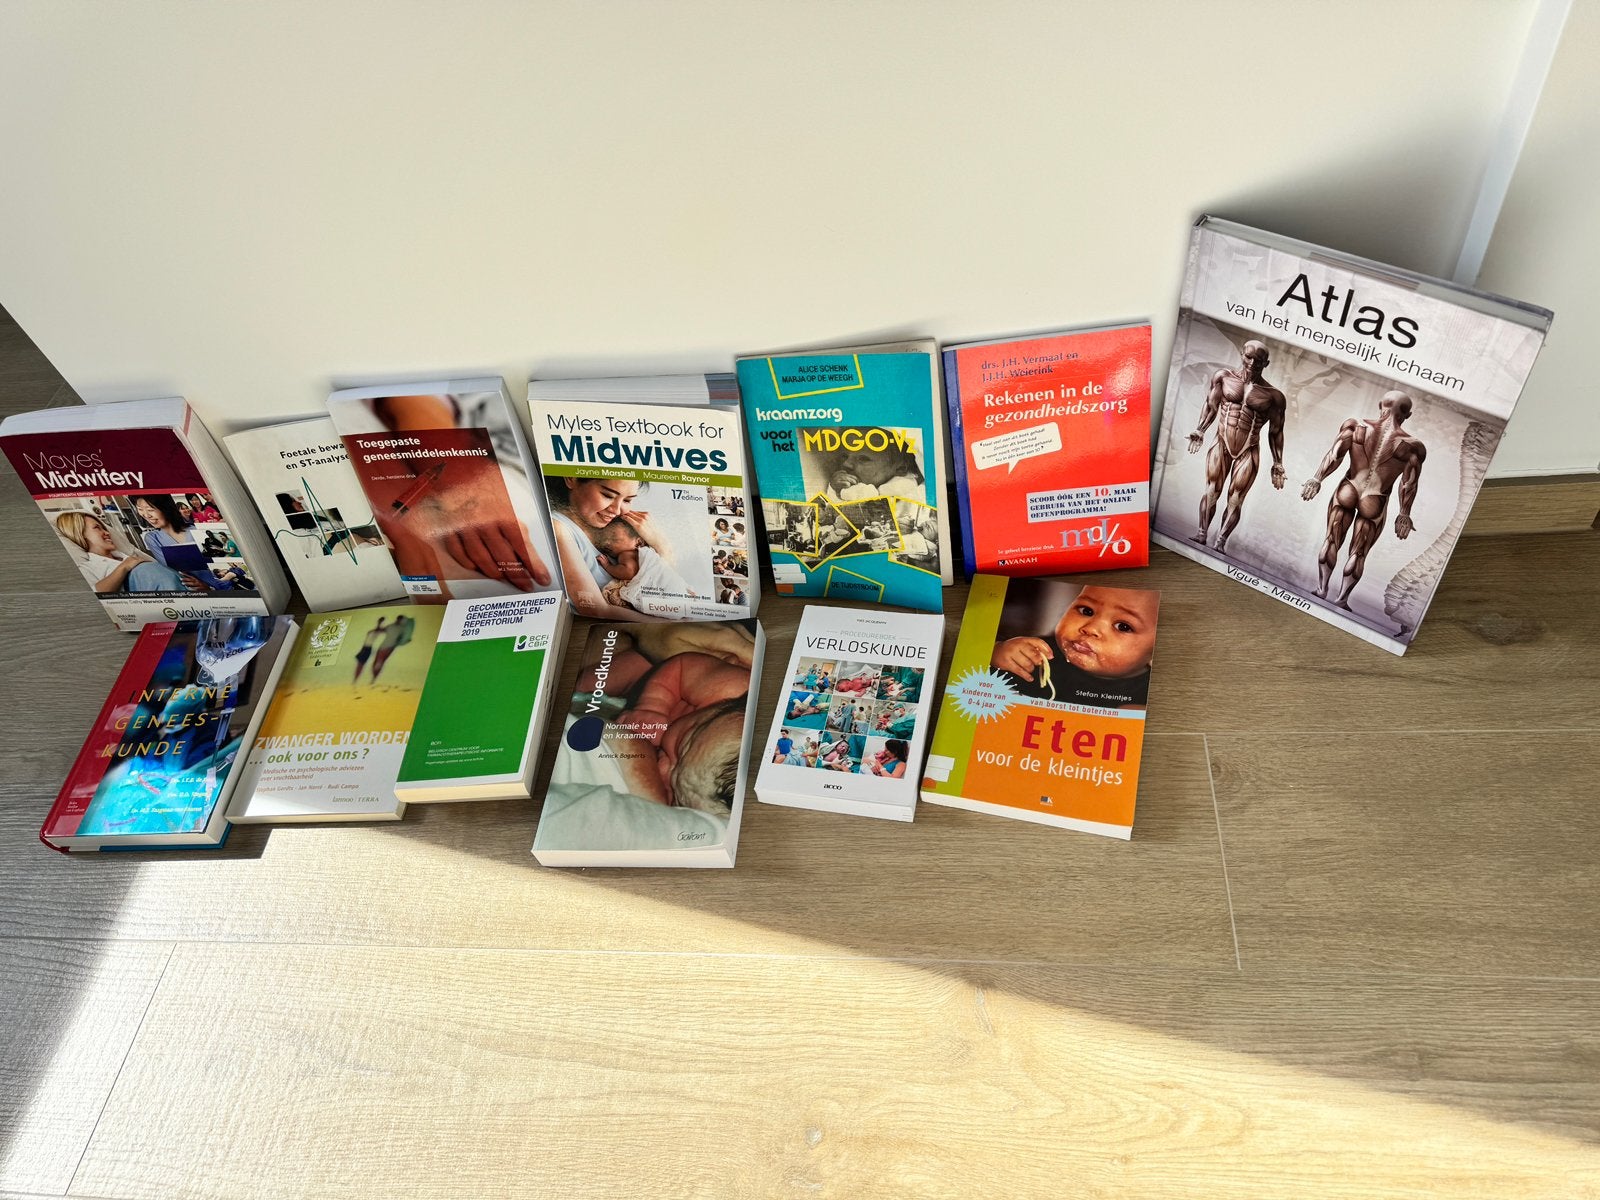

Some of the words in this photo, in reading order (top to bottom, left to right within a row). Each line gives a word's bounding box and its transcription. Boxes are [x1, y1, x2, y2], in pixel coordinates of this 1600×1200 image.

[1276, 273, 1420, 349] Atlas
[1225, 300, 1257, 321] van
[1261, 309, 1291, 332] het
[1294, 322, 1382, 364] menselijk
[1387, 352, 1466, 392] lichaam
[798, 365, 818, 373] ALICE
[819, 364, 849, 373] SCHENK
[981, 360, 1000, 370] drs.
[1002, 357, 1021, 369] J.H.
[1066, 352, 1079, 360] en
[781, 374, 807, 383] MARJA
[807, 374, 817, 383] OP
[817, 374, 827, 382] DE
[828, 373, 854, 382] WEEGH
[983, 388, 1055, 408] Rekenen
[1060, 384, 1077, 398] in
[1081, 381, 1103, 396] de
[755, 407, 843, 423] kraamzorg
[983, 398, 1128, 429] gezondheidszorg
[547, 413, 602, 434] Myles
[605, 416, 694, 438] Textbook
[698, 422, 724, 439] for
[759, 430, 793, 440] voor
[356, 436, 421, 450] Toegepaste
[771, 440, 795, 453] het
[280, 446, 317, 460] Foetale
[363, 447, 489, 464] geneesmiddelenkennis
[550, 434, 728, 472] Midwives
[285, 462, 298, 471] en
[34, 468, 144, 490] Midwifery
[574, 468, 600, 478] Jayne
[601, 468, 636, 478] Marshall
[643, 471, 680, 482] Maureen
[681, 474, 711, 483] Raynor
[681, 494, 704, 502] edition
[1029, 495, 1055, 503] SCOOR
[1057, 492, 1074, 501] ÓÓK
[1076, 491, 1091, 499] EEN
[1094, 487, 1112, 497] 10.
[1113, 487, 1137, 495] MAAK
[1029, 502, 1066, 511] GEBRUIK
[1068, 500, 1083, 508] VAN
[1084, 498, 1102, 506] HET
[1102, 495, 1133, 504] ONLINE
[1030, 506, 1107, 519] OEFENPROGRAMMA!
[998, 556, 1038, 566] KAVANAH
[1225, 564, 1261, 588] Vigué
[831, 580, 840, 589] DE
[840, 581, 881, 592] TIJDSTROOM
[162, 605, 212, 620] evolve
[468, 597, 557, 613] GECOMMENTARIEERD
[648, 603, 680, 613] Evolve
[465, 606, 543, 621] GENEESMIDDELEN-
[463, 616, 524, 628] REPERTORIUM
[322, 625, 339, 636] 20
[461, 628, 480, 637] 2019
[839, 629, 897, 641] PROCEDUREBOEK
[806, 636, 928, 660] VERLOSKUNDE
[585, 630, 618, 714] Vroedkunde
[979, 681, 994, 689] voor
[129, 685, 234, 704] INTERNE
[962, 688, 992, 698] kinderen
[1075, 689, 1099, 699] Stefan
[1100, 692, 1133, 703] Kleintjes
[968, 698, 980, 706] 0-4
[981, 701, 996, 709] jaar
[1030, 699, 1045, 707] van
[1046, 700, 1067, 710] borst
[1068, 702, 1081, 712] tot
[1081, 704, 1120, 717] boterham
[113, 712, 219, 731] GENEES-
[605, 722, 640, 730] Normale
[641, 722, 668, 731] baring
[254, 731, 335, 750] ZWANGER
[1021, 715, 1128, 763] Eten
[100, 740, 187, 758] KUNDE
[267, 751, 292, 764] ook
[297, 750, 330, 762] voor
[333, 750, 359, 760] ons
[362, 748, 370, 760] ?
[296, 765, 341, 775] psychologische
[976, 749, 1013, 766] voor
[1019, 753, 1041, 772] de
[1048, 757, 1124, 787] kleintjes
[273, 774, 314, 782] vruchtbaarheid
[823, 783, 843, 791] acco
